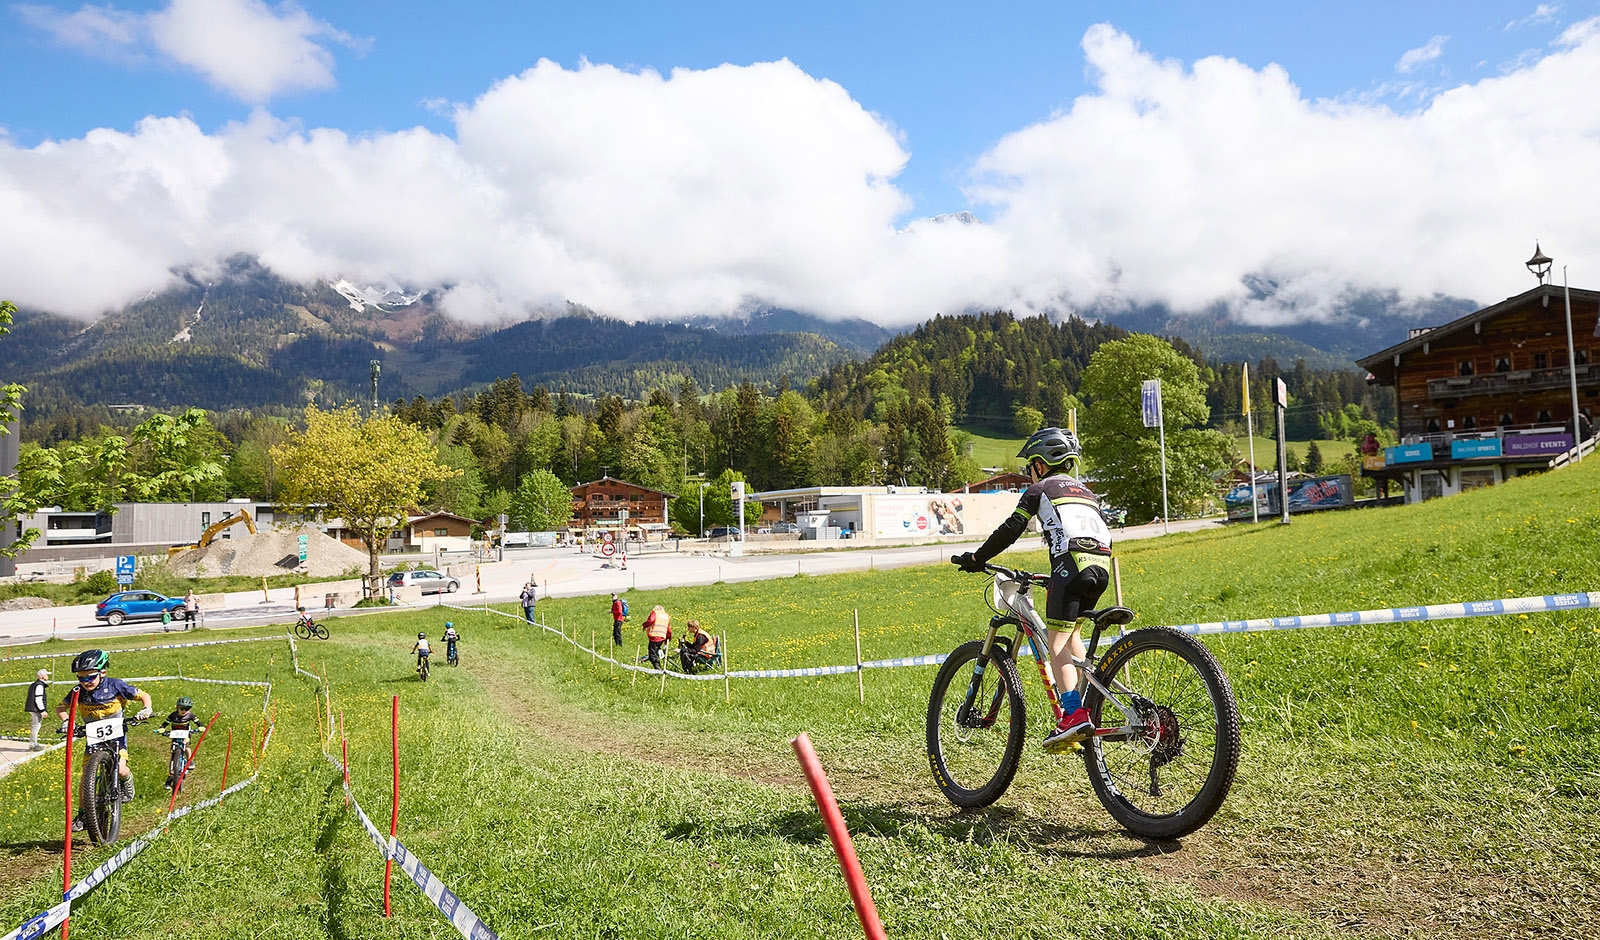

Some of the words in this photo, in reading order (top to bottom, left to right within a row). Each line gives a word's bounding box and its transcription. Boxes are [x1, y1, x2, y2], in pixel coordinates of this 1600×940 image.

[1512, 442, 1538, 450] WALDHOF
[1075, 514, 1100, 534] 70
[119, 556, 128, 568] P
[1100, 640, 1134, 672] MAXXIS
[96, 725, 114, 738] 53
[930, 754, 948, 788] MAXXIS
